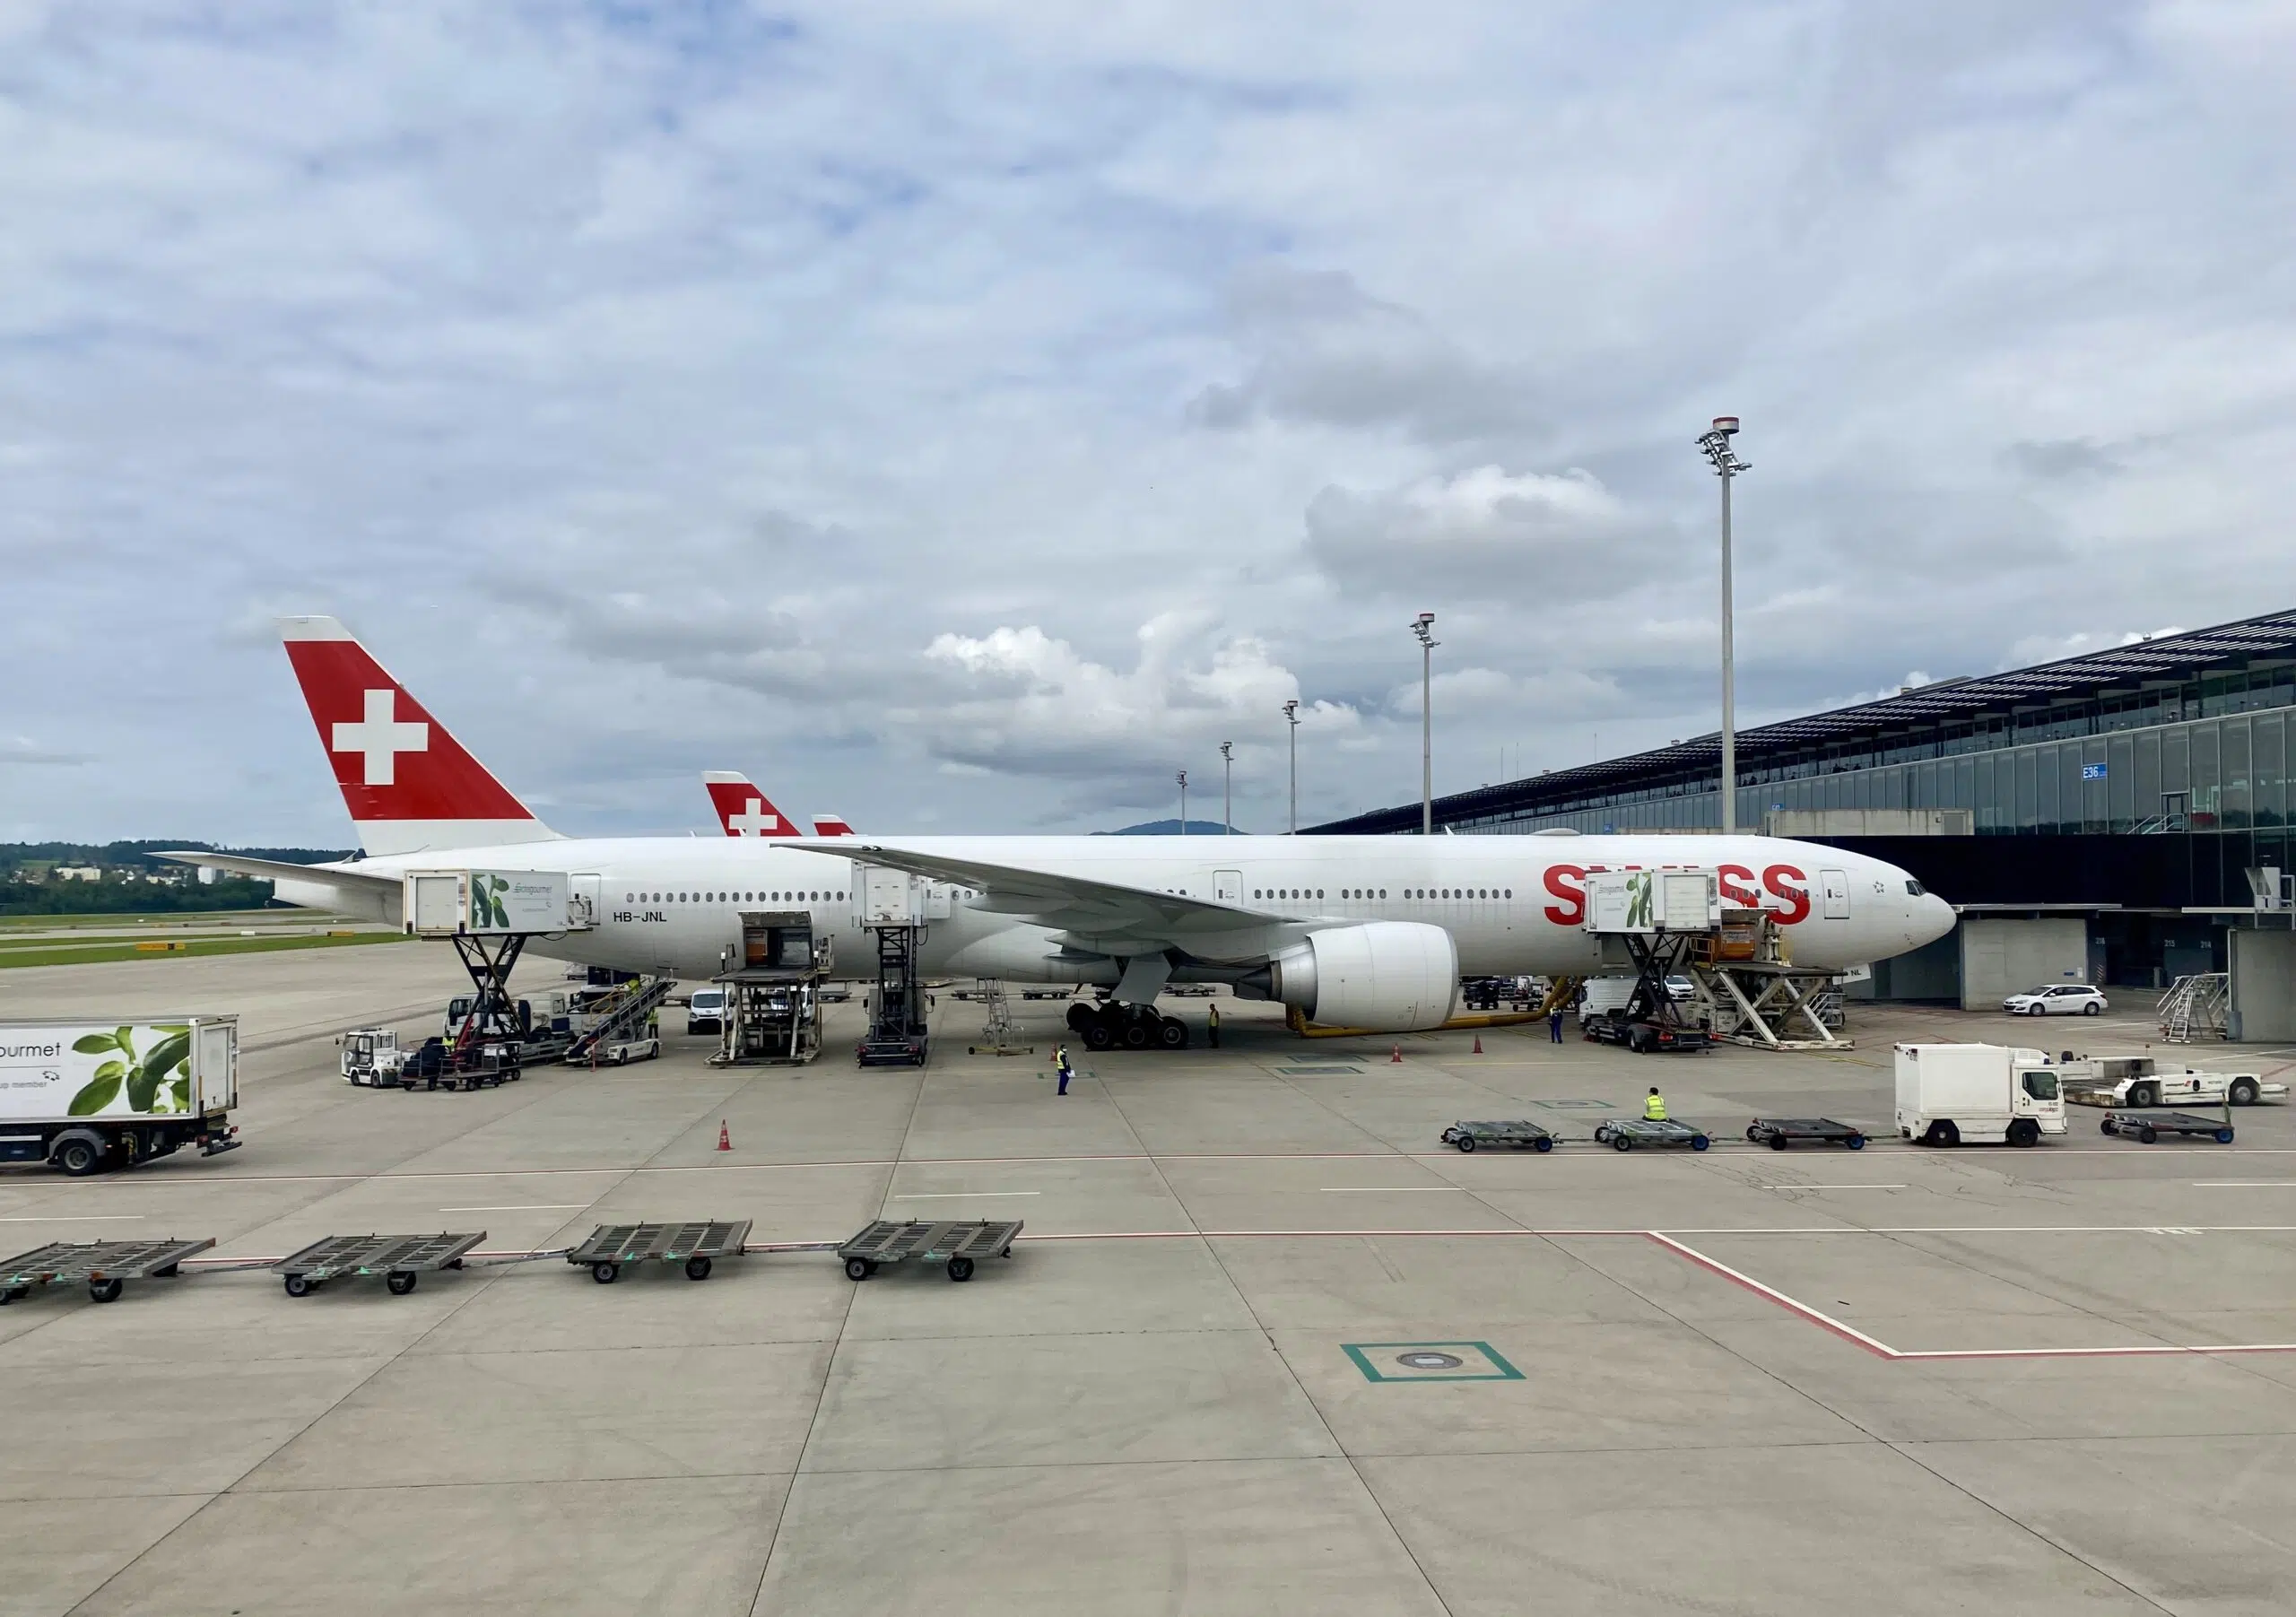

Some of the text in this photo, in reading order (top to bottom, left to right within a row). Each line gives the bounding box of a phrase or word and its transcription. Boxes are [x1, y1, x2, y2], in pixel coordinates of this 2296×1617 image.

[2083, 766, 2099, 778] E36
[1543, 864, 1811, 926] SSS
[613, 911, 667, 922] HB-JNL
